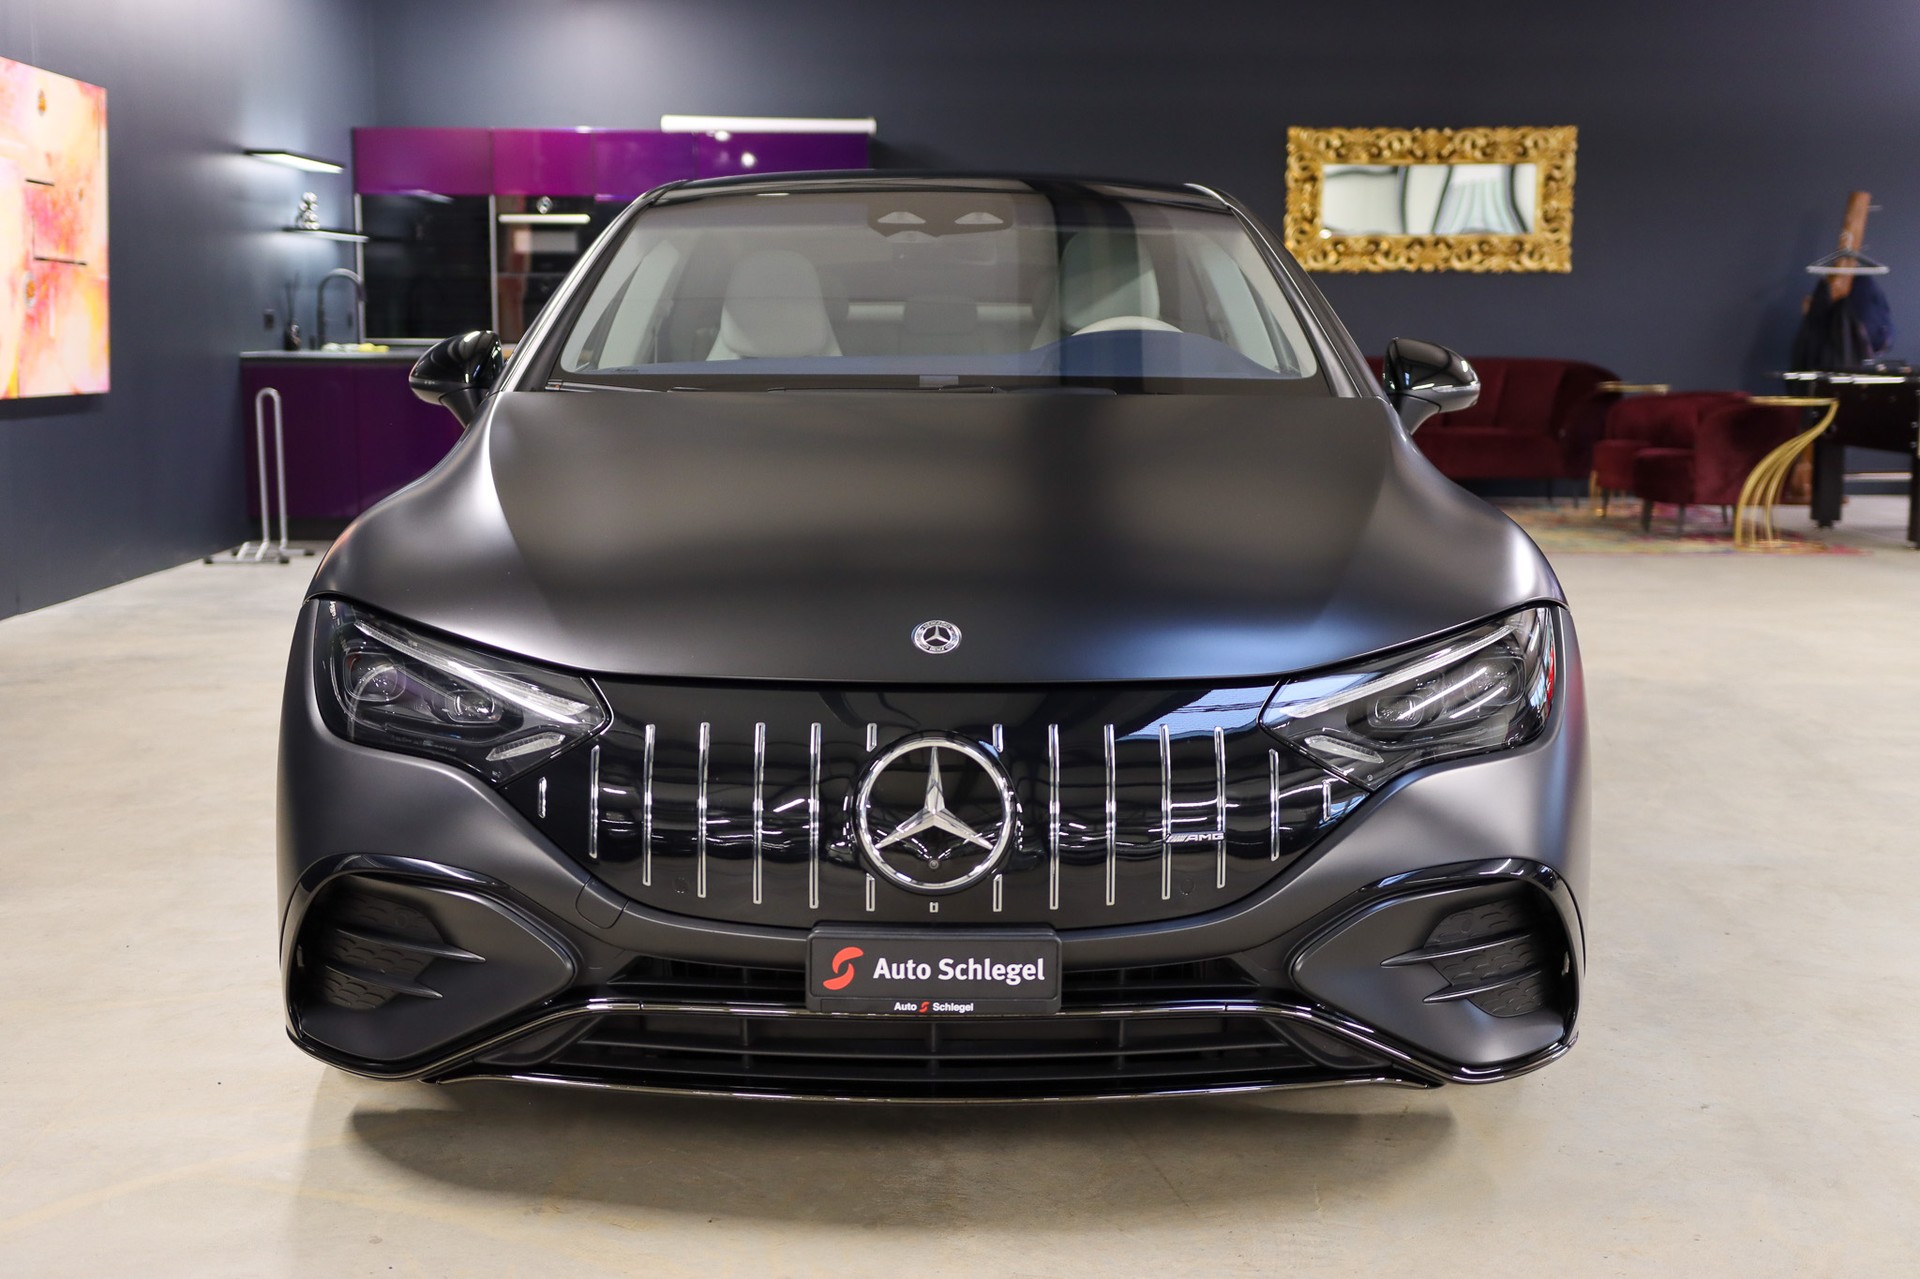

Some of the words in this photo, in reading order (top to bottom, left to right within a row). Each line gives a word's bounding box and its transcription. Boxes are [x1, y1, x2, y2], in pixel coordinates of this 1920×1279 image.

[1184, 833, 1225, 842] AMG
[872, 957, 932, 980] Auto
[937, 957, 1046, 986] Schlegel
[893, 1002, 918, 1012] Auto
[932, 1002, 974, 1014] Schlegel
